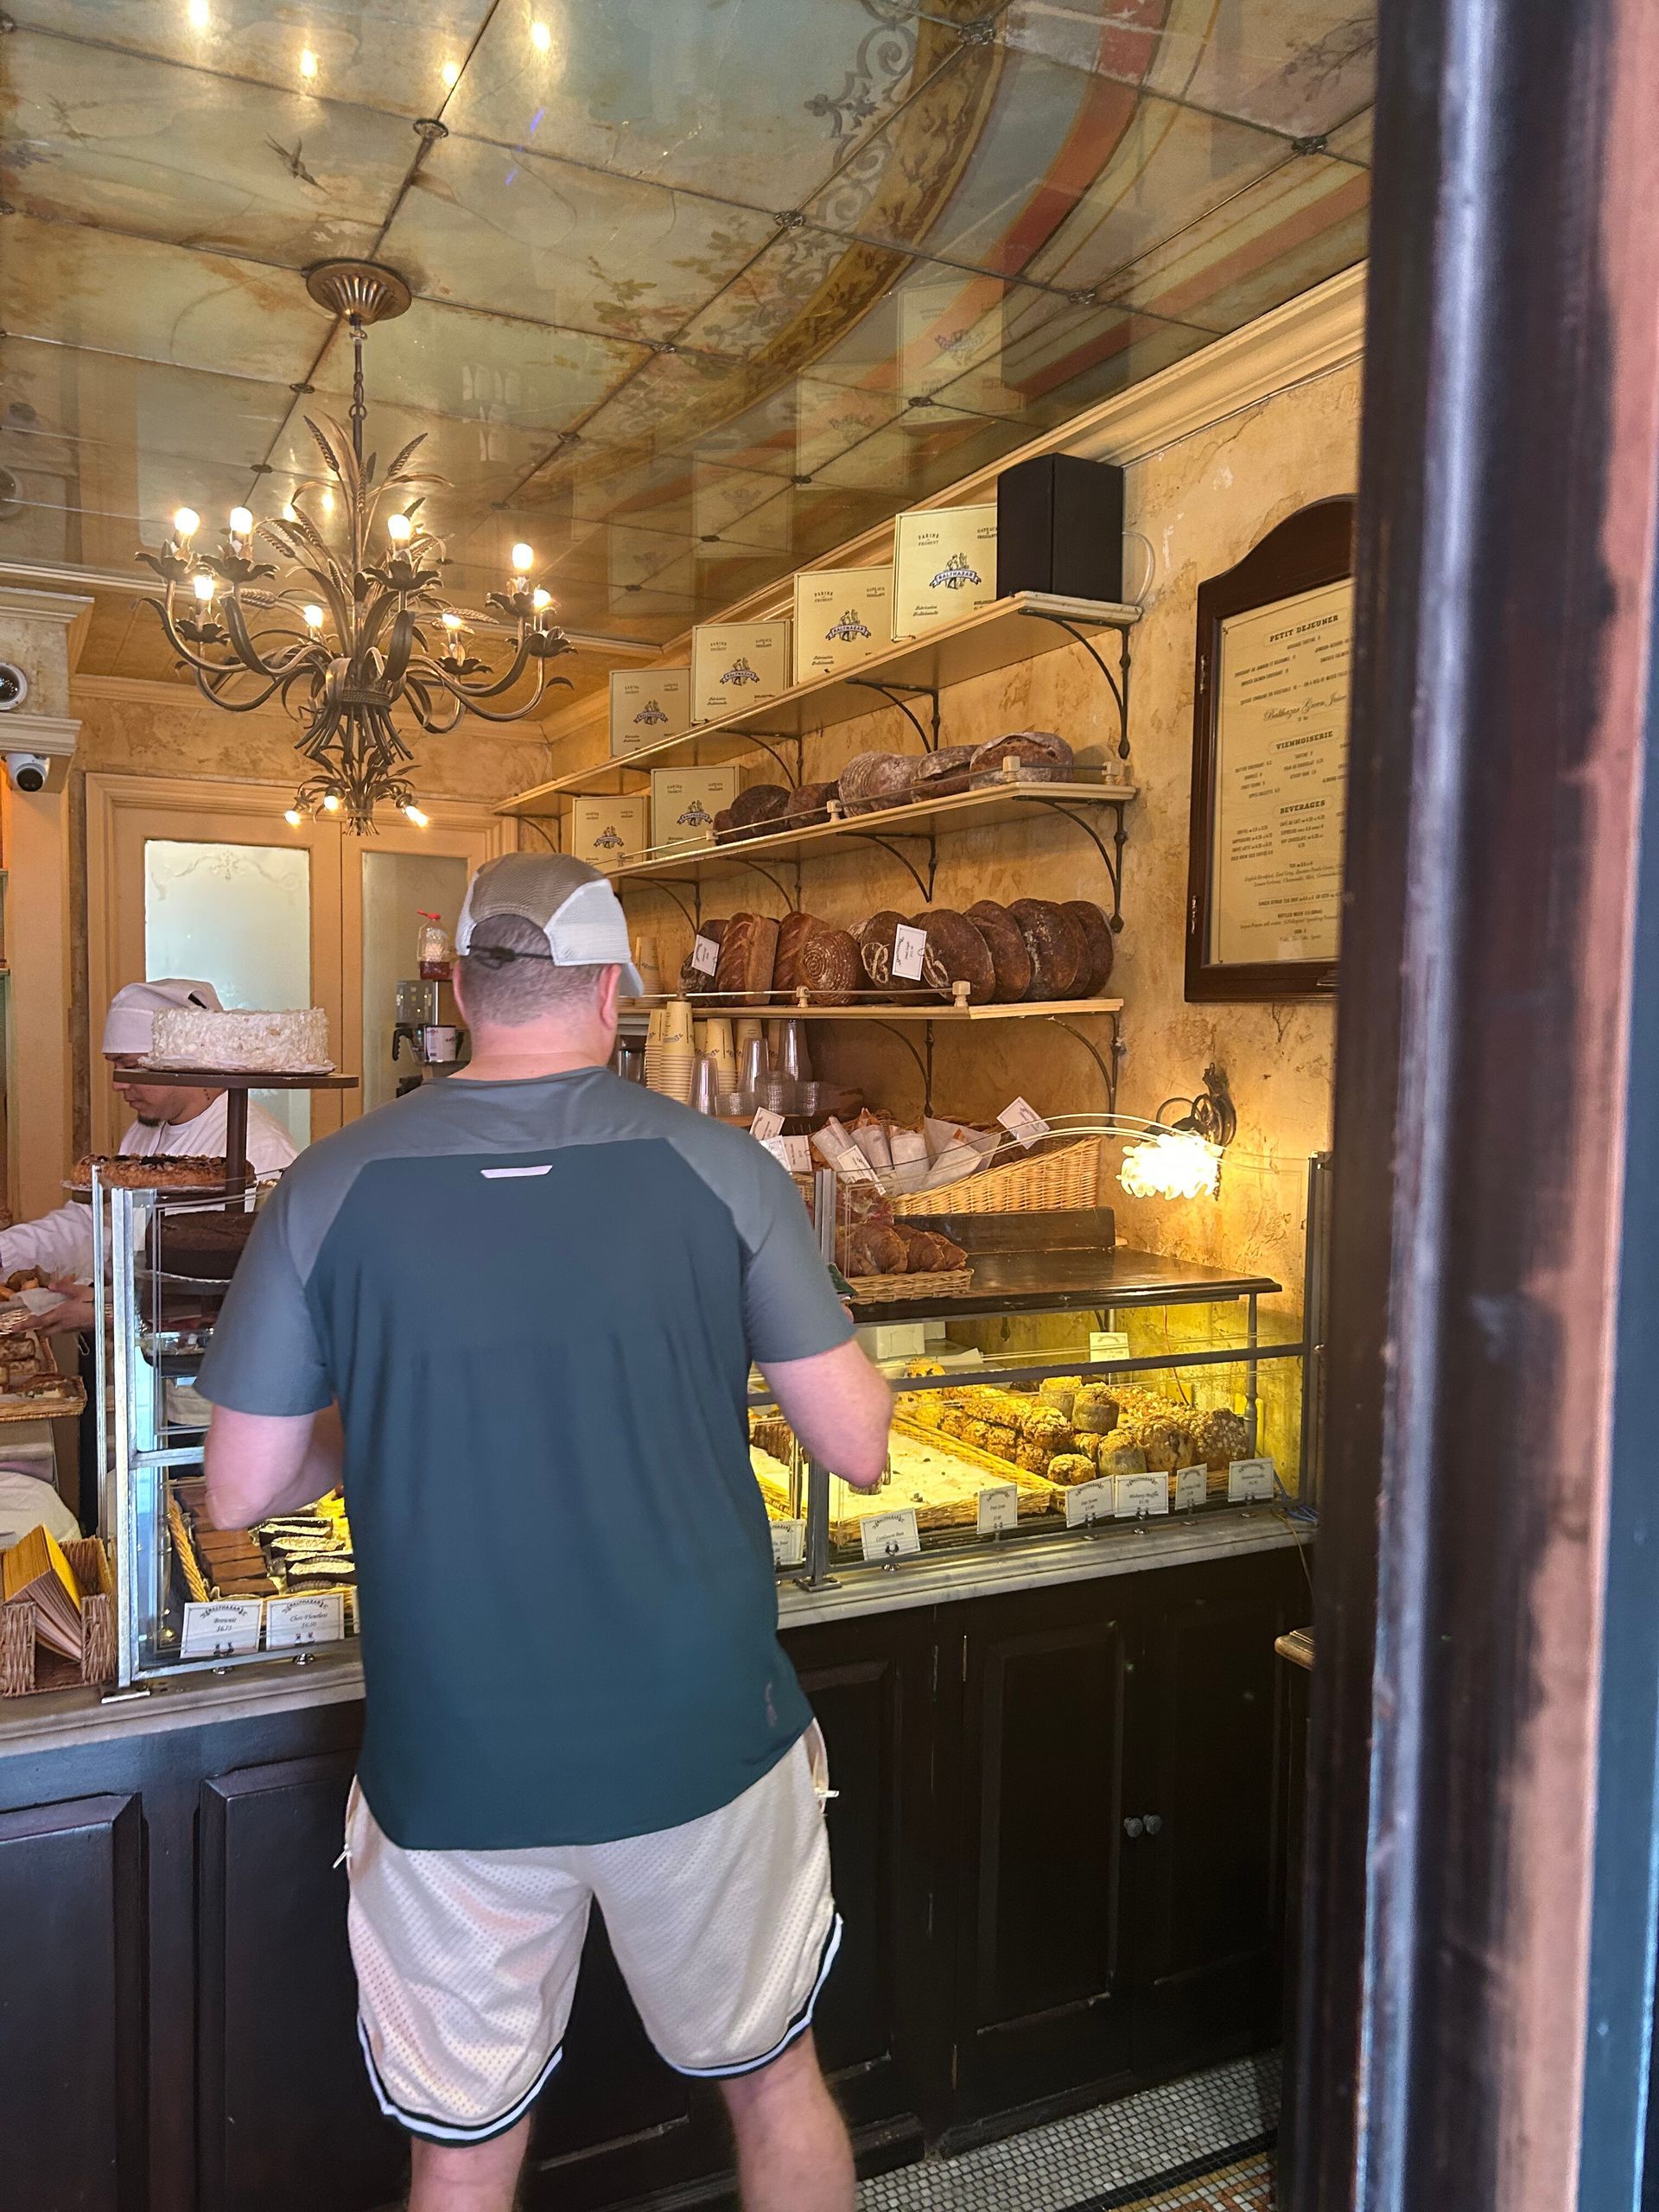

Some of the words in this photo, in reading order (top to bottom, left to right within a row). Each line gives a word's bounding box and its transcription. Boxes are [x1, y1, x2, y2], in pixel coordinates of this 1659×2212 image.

[938, 570, 974, 580] BALTHAZAR
[1269, 629, 1294, 642] PETIT
[1296, 614, 1338, 633] DEJEUNER
[1275, 730, 1333, 750] VIENNOISERIE
[1280, 800, 1325, 814] BEVERAGES
[289, 1599, 321, 1607] BALTHAZAR
